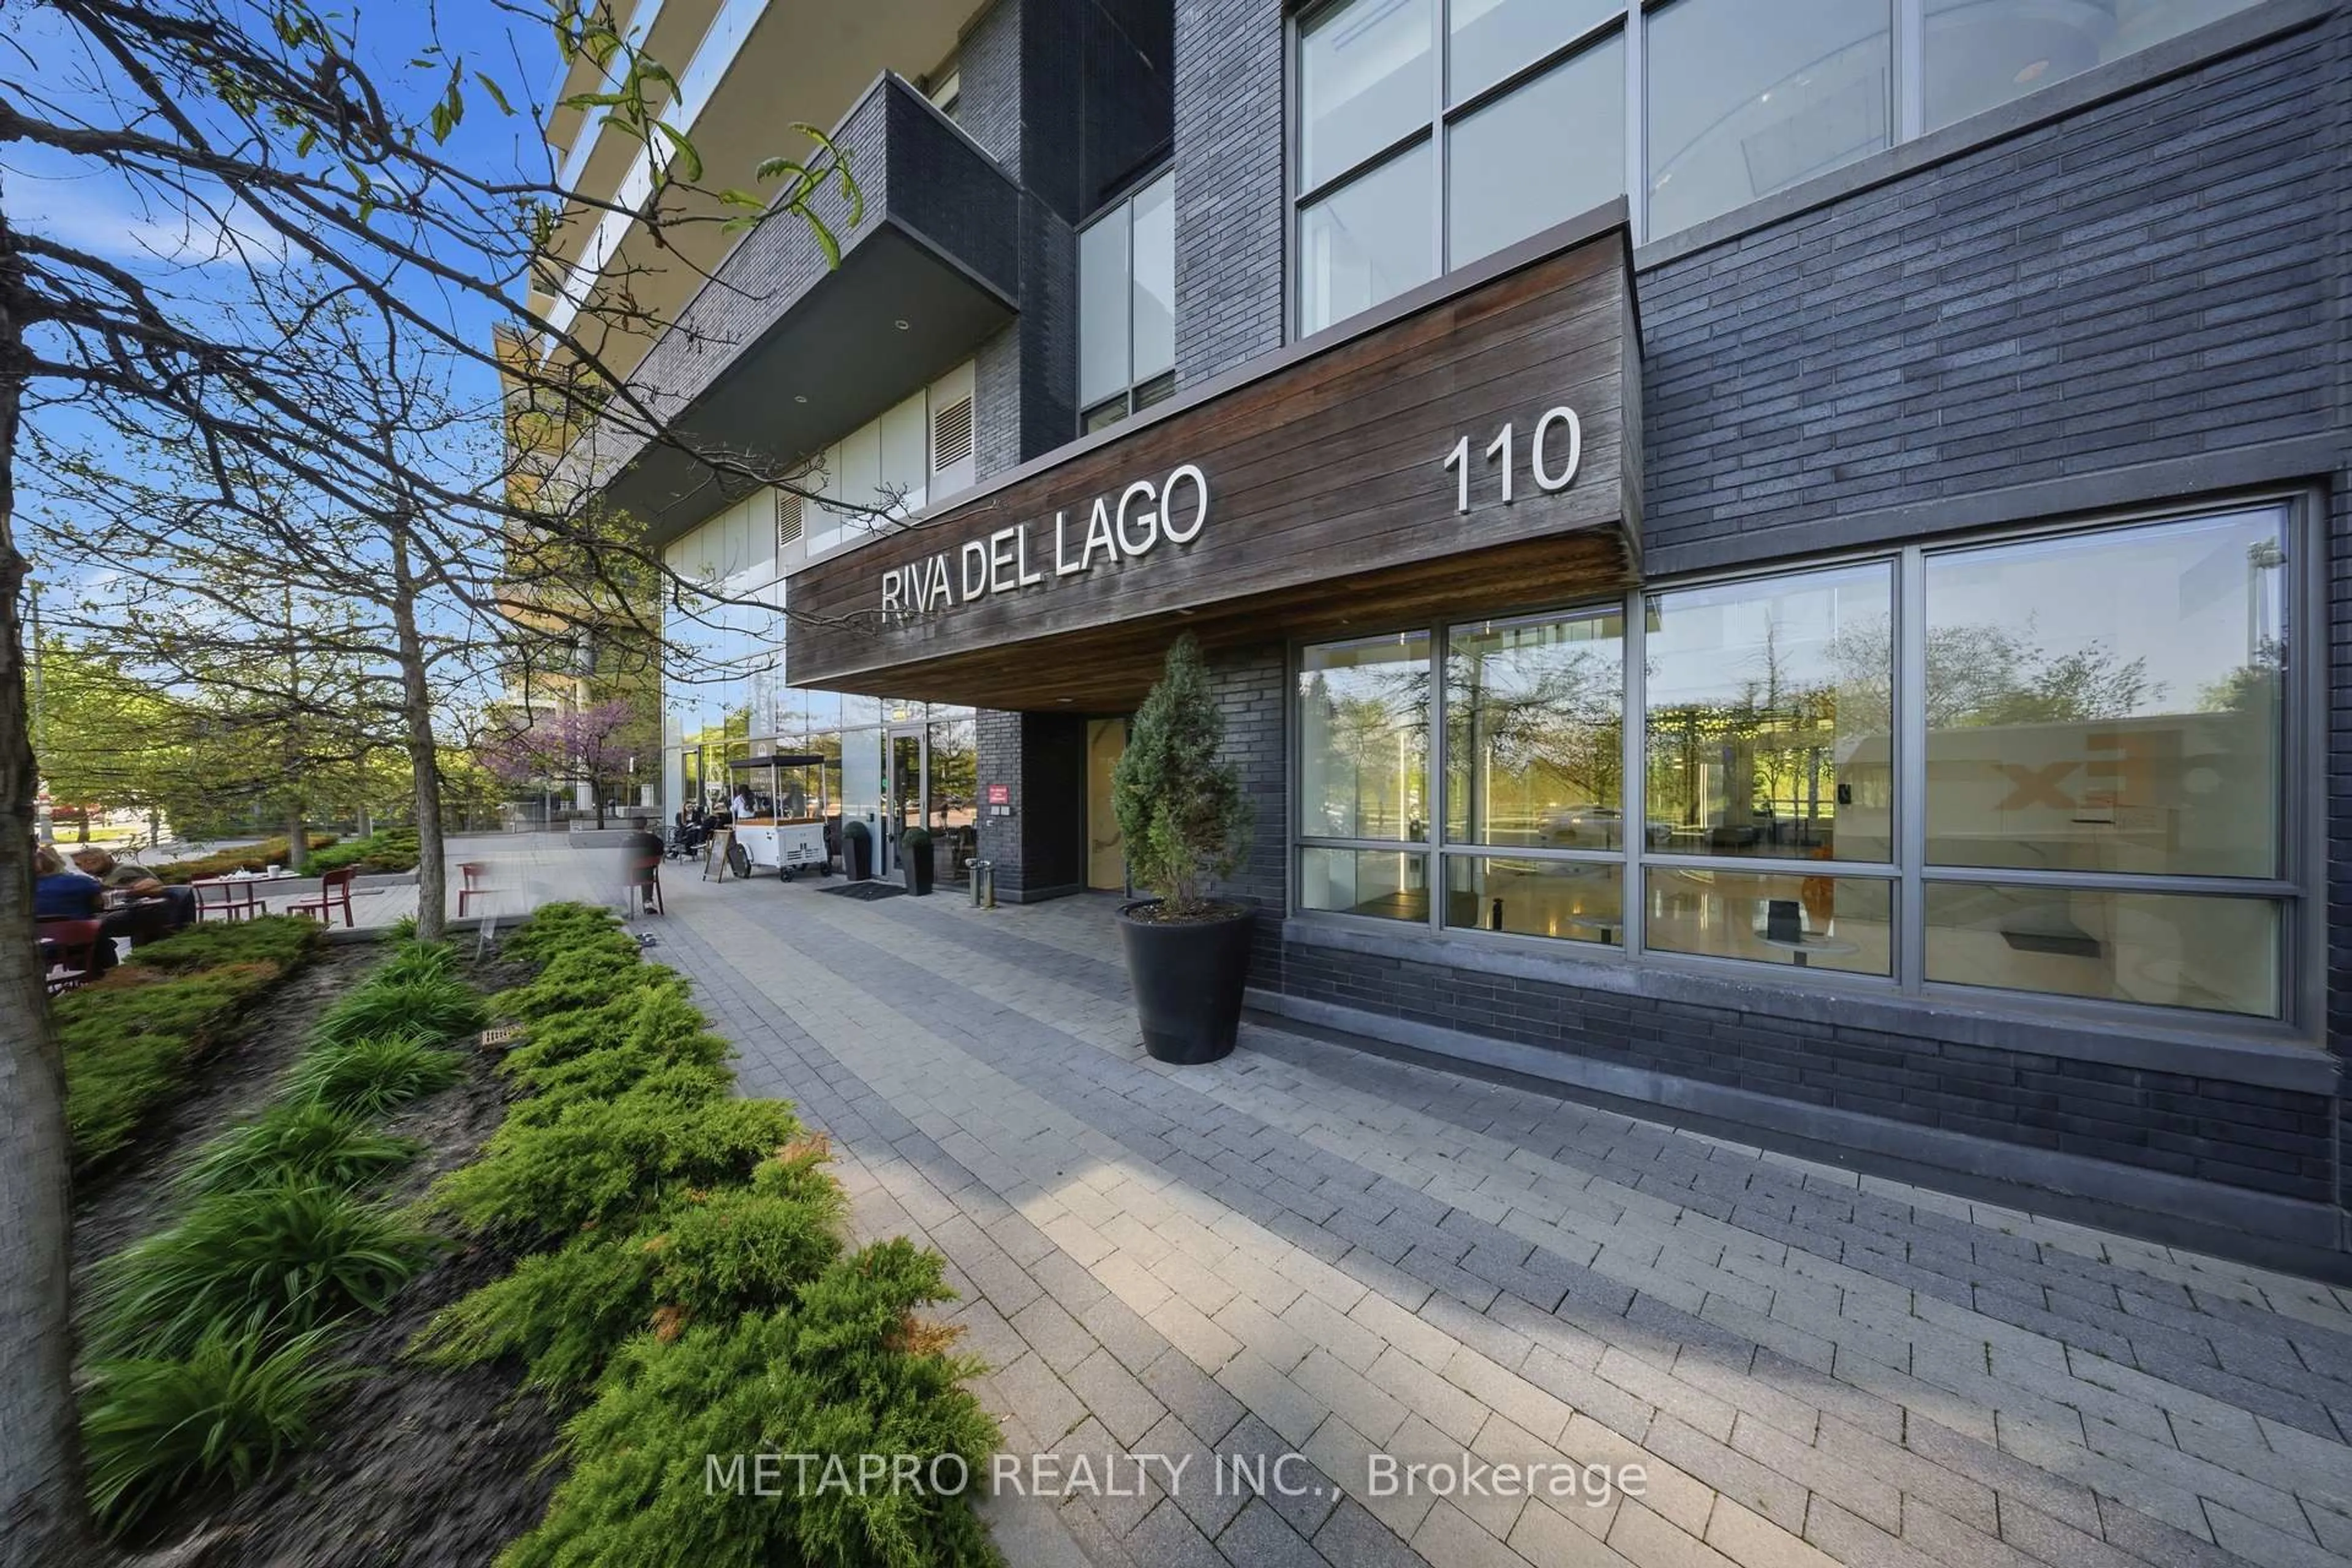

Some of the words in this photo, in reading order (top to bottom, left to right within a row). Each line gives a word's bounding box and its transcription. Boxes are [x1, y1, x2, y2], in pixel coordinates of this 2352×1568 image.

[1444, 406, 1581, 511] 110
[882, 554, 952, 624] RIVA
[962, 524, 1041, 602] DEL
[1055, 464, 1208, 576] LAGO
